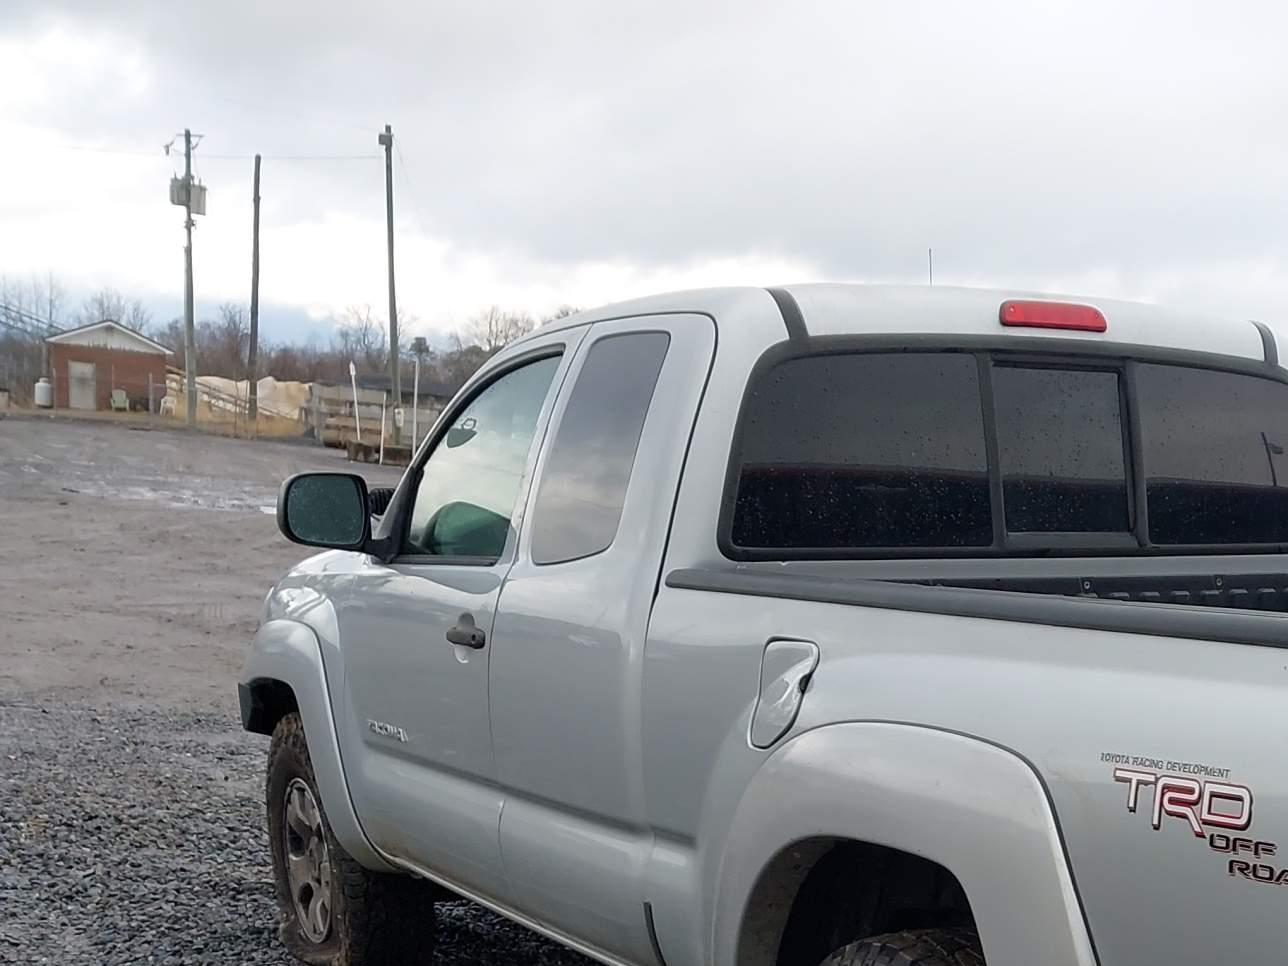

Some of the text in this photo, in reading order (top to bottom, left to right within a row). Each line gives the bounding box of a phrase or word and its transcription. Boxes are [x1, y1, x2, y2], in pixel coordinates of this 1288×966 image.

[1100, 752, 1231, 779] TOYOTA RACING DEVELOPMENT
[1113, 767, 1254, 839] TRD
[1208, 832, 1278, 859] OFF
